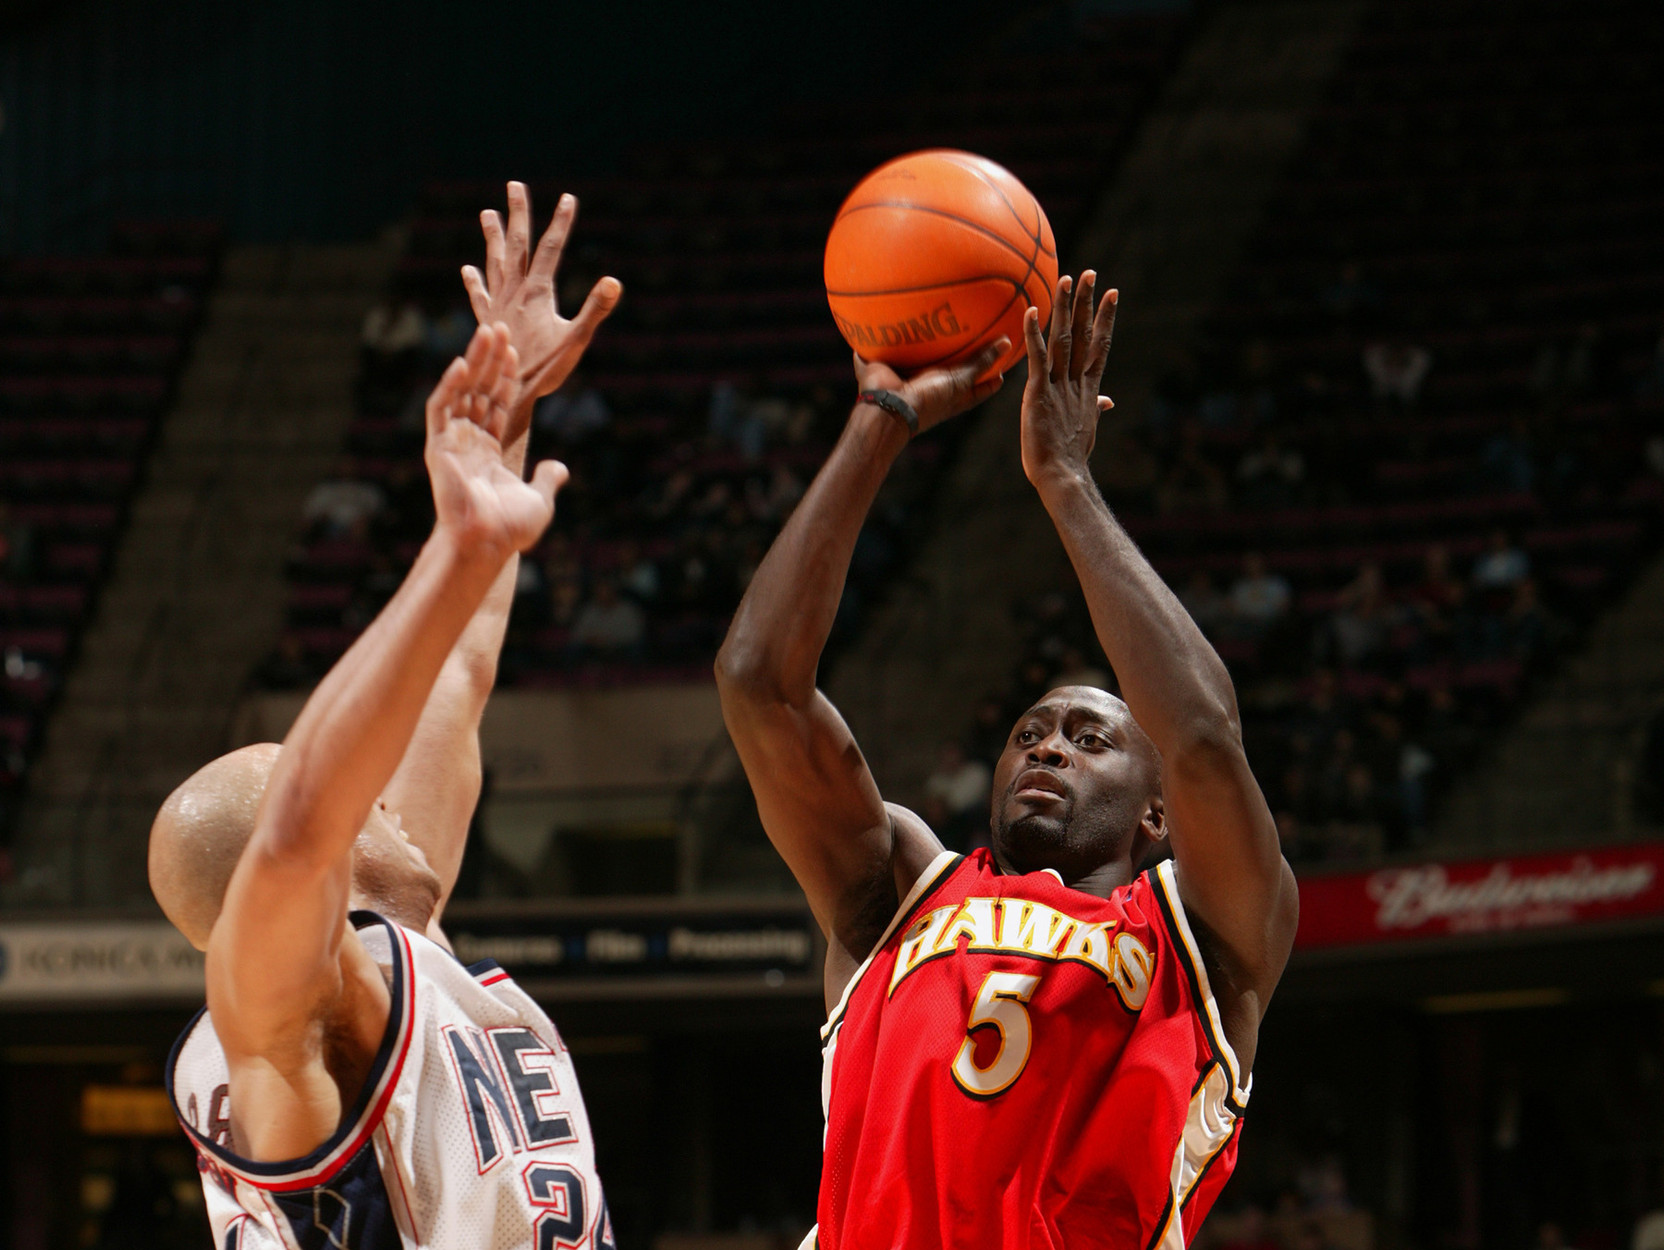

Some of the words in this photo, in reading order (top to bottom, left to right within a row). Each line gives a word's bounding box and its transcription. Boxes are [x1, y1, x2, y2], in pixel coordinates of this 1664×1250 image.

[888, 897, 1155, 1014] HAWKS
[442, 1024, 579, 1175] NE
[951, 971, 1042, 1101] 5
